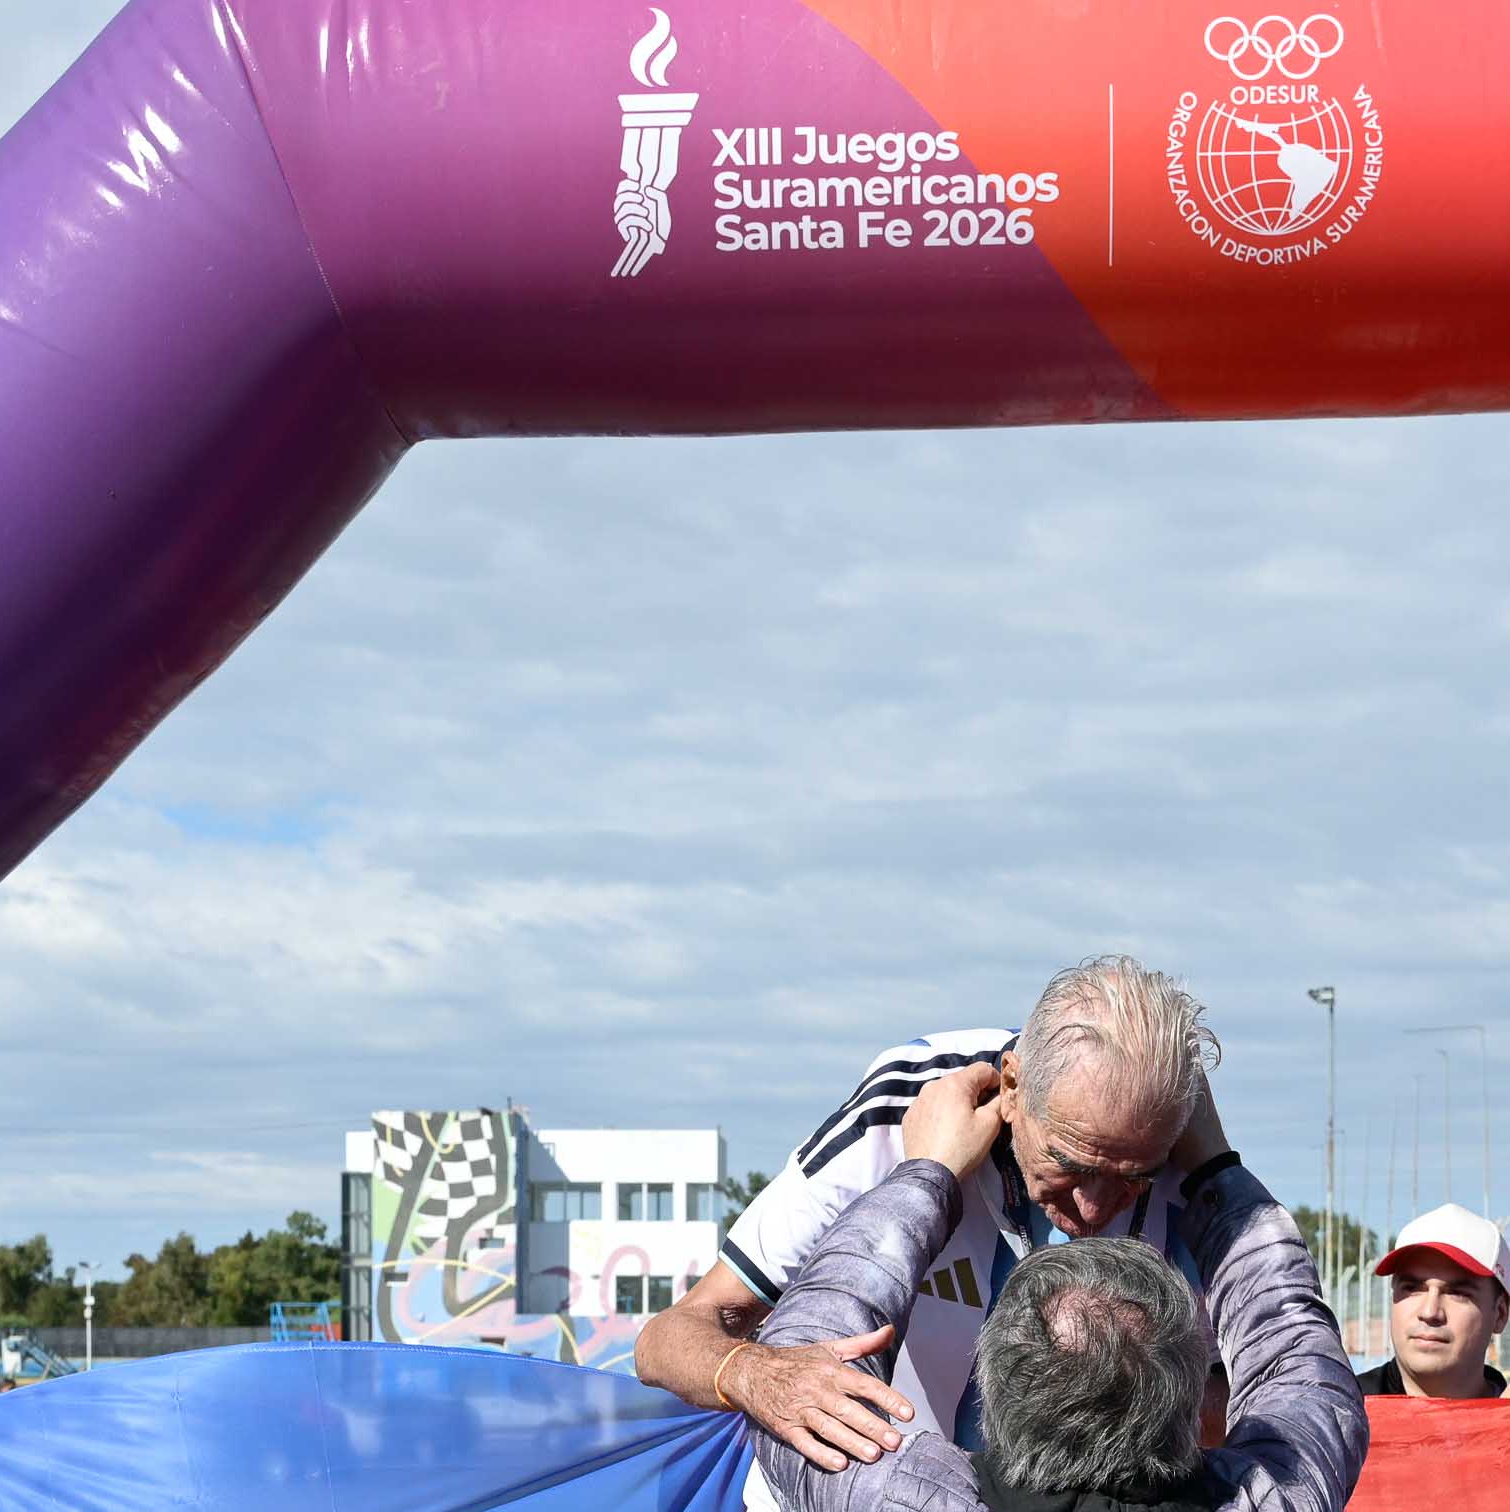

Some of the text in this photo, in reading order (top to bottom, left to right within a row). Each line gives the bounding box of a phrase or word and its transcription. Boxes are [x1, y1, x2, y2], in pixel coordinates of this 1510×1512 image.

[1230, 84, 1320, 105] ODESUR
[711, 126, 959, 172] XIII Juegos
[713, 163, 1060, 210] Suramericanos
[1166, 84, 1384, 265] ORGANIZACION DEPORTIVA SURAMERICANA
[714, 208, 1035, 252] Santa Fe 2026
